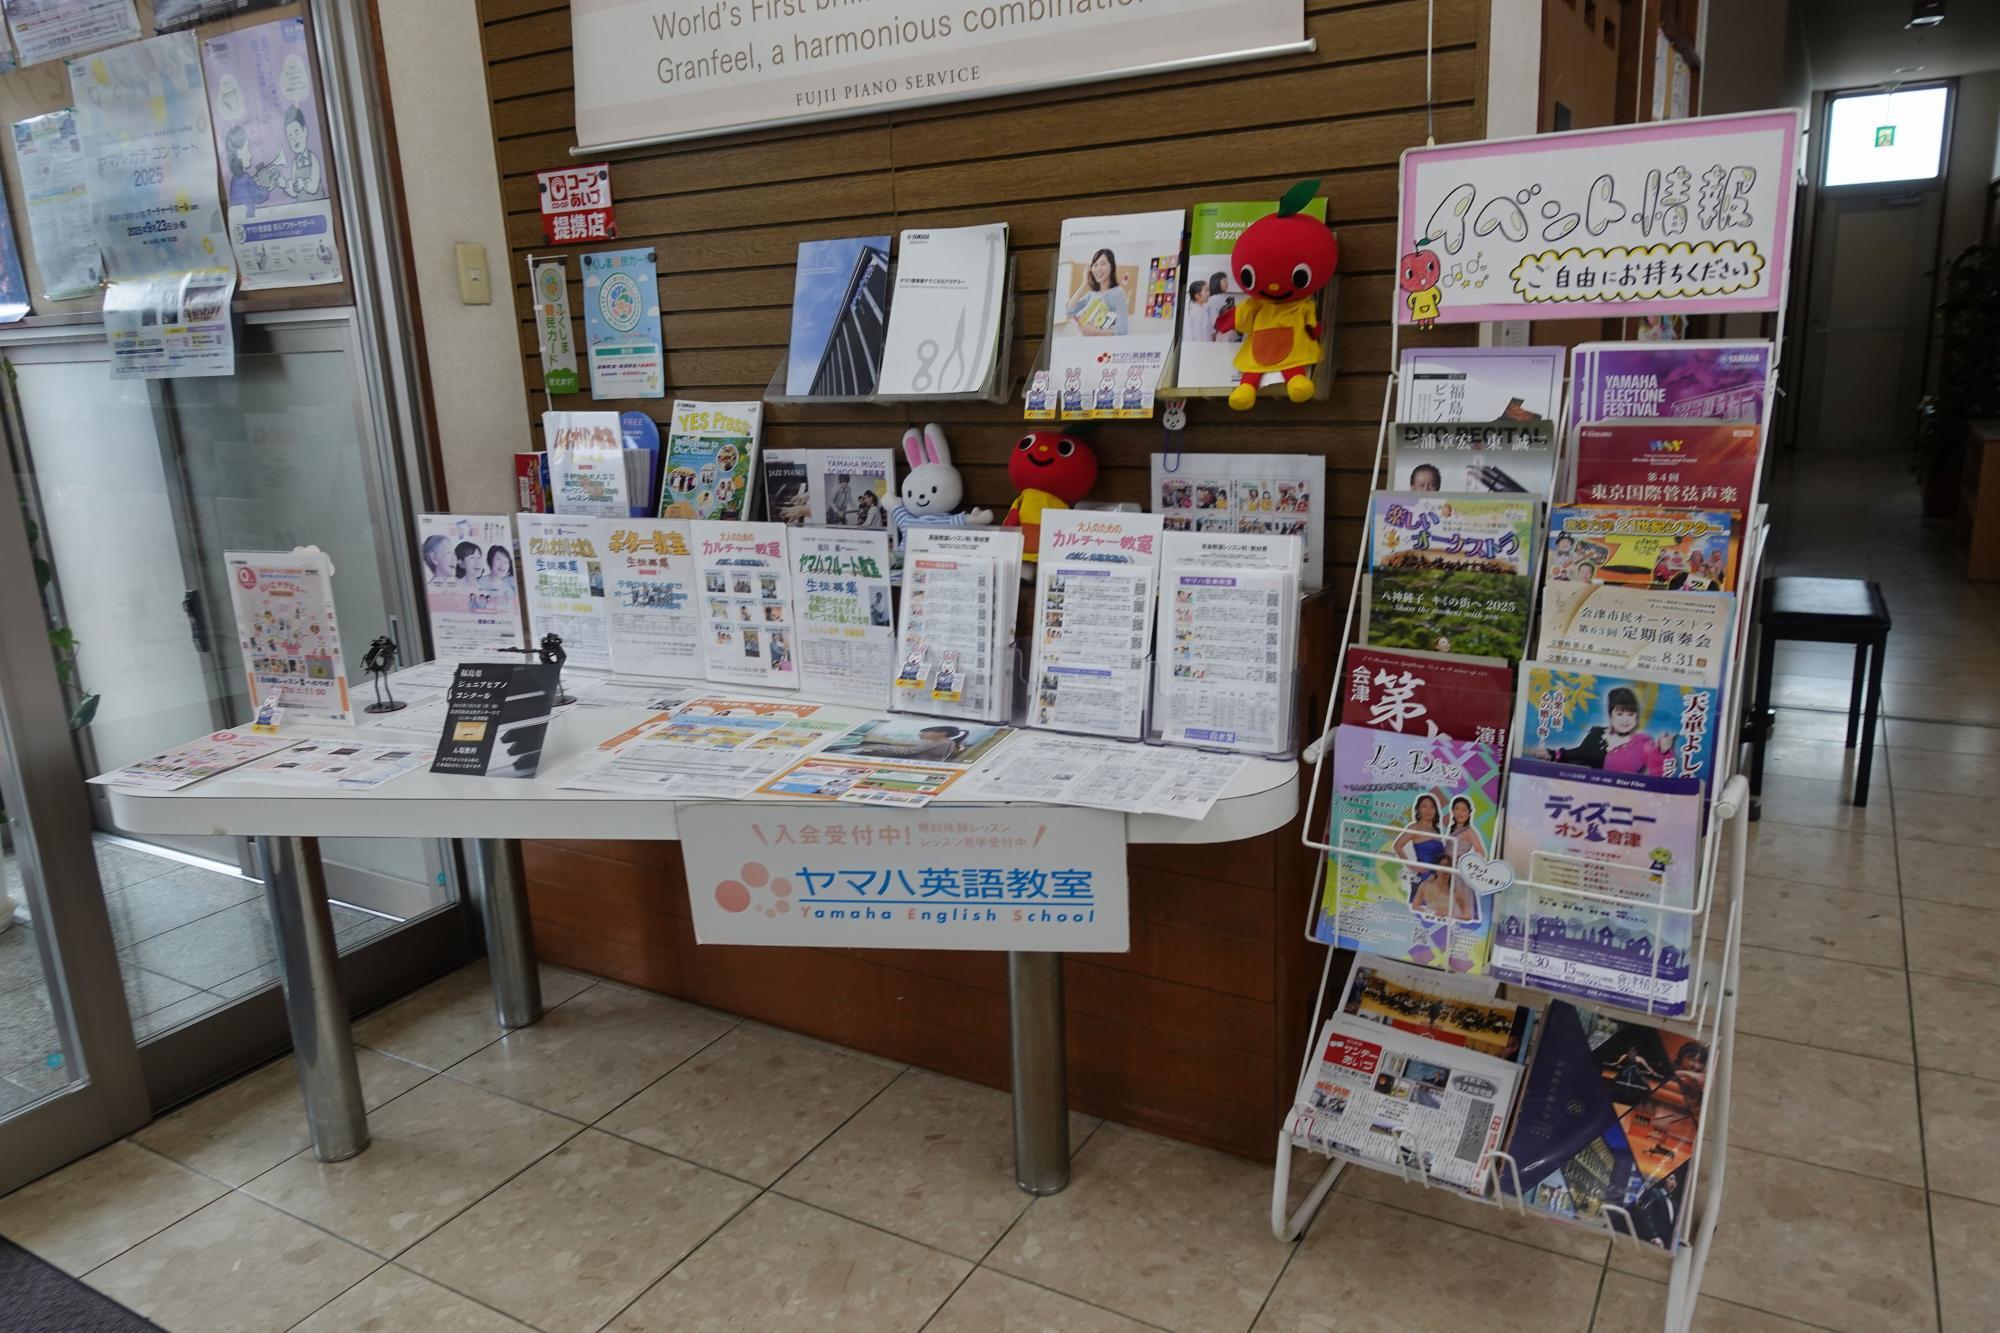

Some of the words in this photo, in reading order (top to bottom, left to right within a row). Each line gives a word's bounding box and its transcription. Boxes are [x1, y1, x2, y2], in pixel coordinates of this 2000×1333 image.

[653, 2, 742, 40] World's
[657, 43, 762, 84] Granfeel,
[771, 44, 785, 65] a
[795, 15, 952, 61] harmonious
[796, 88, 837, 107] FUJII
[844, 78, 898, 99] PIANO
[905, 65, 981, 91] SERVICE
[133, 166, 164, 187] 2025
[567, 171, 599, 191] コープ
[1425, 165, 1757, 255] イベント情報
[553, 211, 606, 241] 提携店
[1528, 258, 1749, 289] ご自由にお持ちください
[557, 304, 569, 354] ふくしま
[1729, 353, 1761, 363] YAMAHA
[1605, 375, 1658, 389] YAMAHA
[1604, 388, 1666, 403] ELECTONE
[1603, 402, 1660, 417] FESTIVAL
[623, 417, 643, 426] FREE
[678, 411, 710, 433] YES
[675, 437, 709, 448] Welcome
[1405, 427, 1449, 443] DUO
[1456, 427, 1548, 444] RECITAL
[673, 446, 690, 454] Our
[768, 469, 783, 477] JAZZ
[783, 469, 805, 477] PIANO
[827, 460, 860, 468] YAMAHA
[1384, 503, 1440, 530] 楽しい
[1077, 521, 1122, 534] 大人のための
[608, 530, 691, 555] ギター教室
[702, 540, 782, 559] カルチャー教室
[1052, 530, 1154, 555] カルチャー教室
[626, 556, 669, 570] 生徒募集
[799, 553, 883, 578] ヤマハフルート教室
[806, 577, 859, 597] 生徒募集
[1485, 599, 1516, 613] 2025
[1580, 606, 1714, 631] 会津市民オーケストラ
[1622, 625, 1713, 649] 定期演奏会
[460, 669, 483, 677] 福島県
[457, 681, 508, 689] ジュニアピアノ
[1351, 664, 1372, 703] 会津
[456, 692, 492, 700] コンクール
[1365, 744, 1399, 770] La
[1407, 750, 1463, 779] Diva
[1615, 778, 1630, 786] Star
[1631, 780, 1646, 788] Film
[1544, 794, 1657, 826] ディズニー
[773, 824, 912, 846] 入会受付中!
[917, 822, 1010, 833] 無料体験レッスン
[1554, 823, 1585, 838] オン
[1607, 829, 1642, 848] 會津
[920, 836, 1027, 848] レッスン見学受付中
[795, 866, 1095, 899] ヤマハ英語教室
[800, 906, 892, 920] Yamaha
[908, 907, 997, 924] English
[1013, 909, 1095, 923] School
[1617, 973, 1673, 995] 會津稽堂
[1343, 1045, 1379, 1060] サンデー
